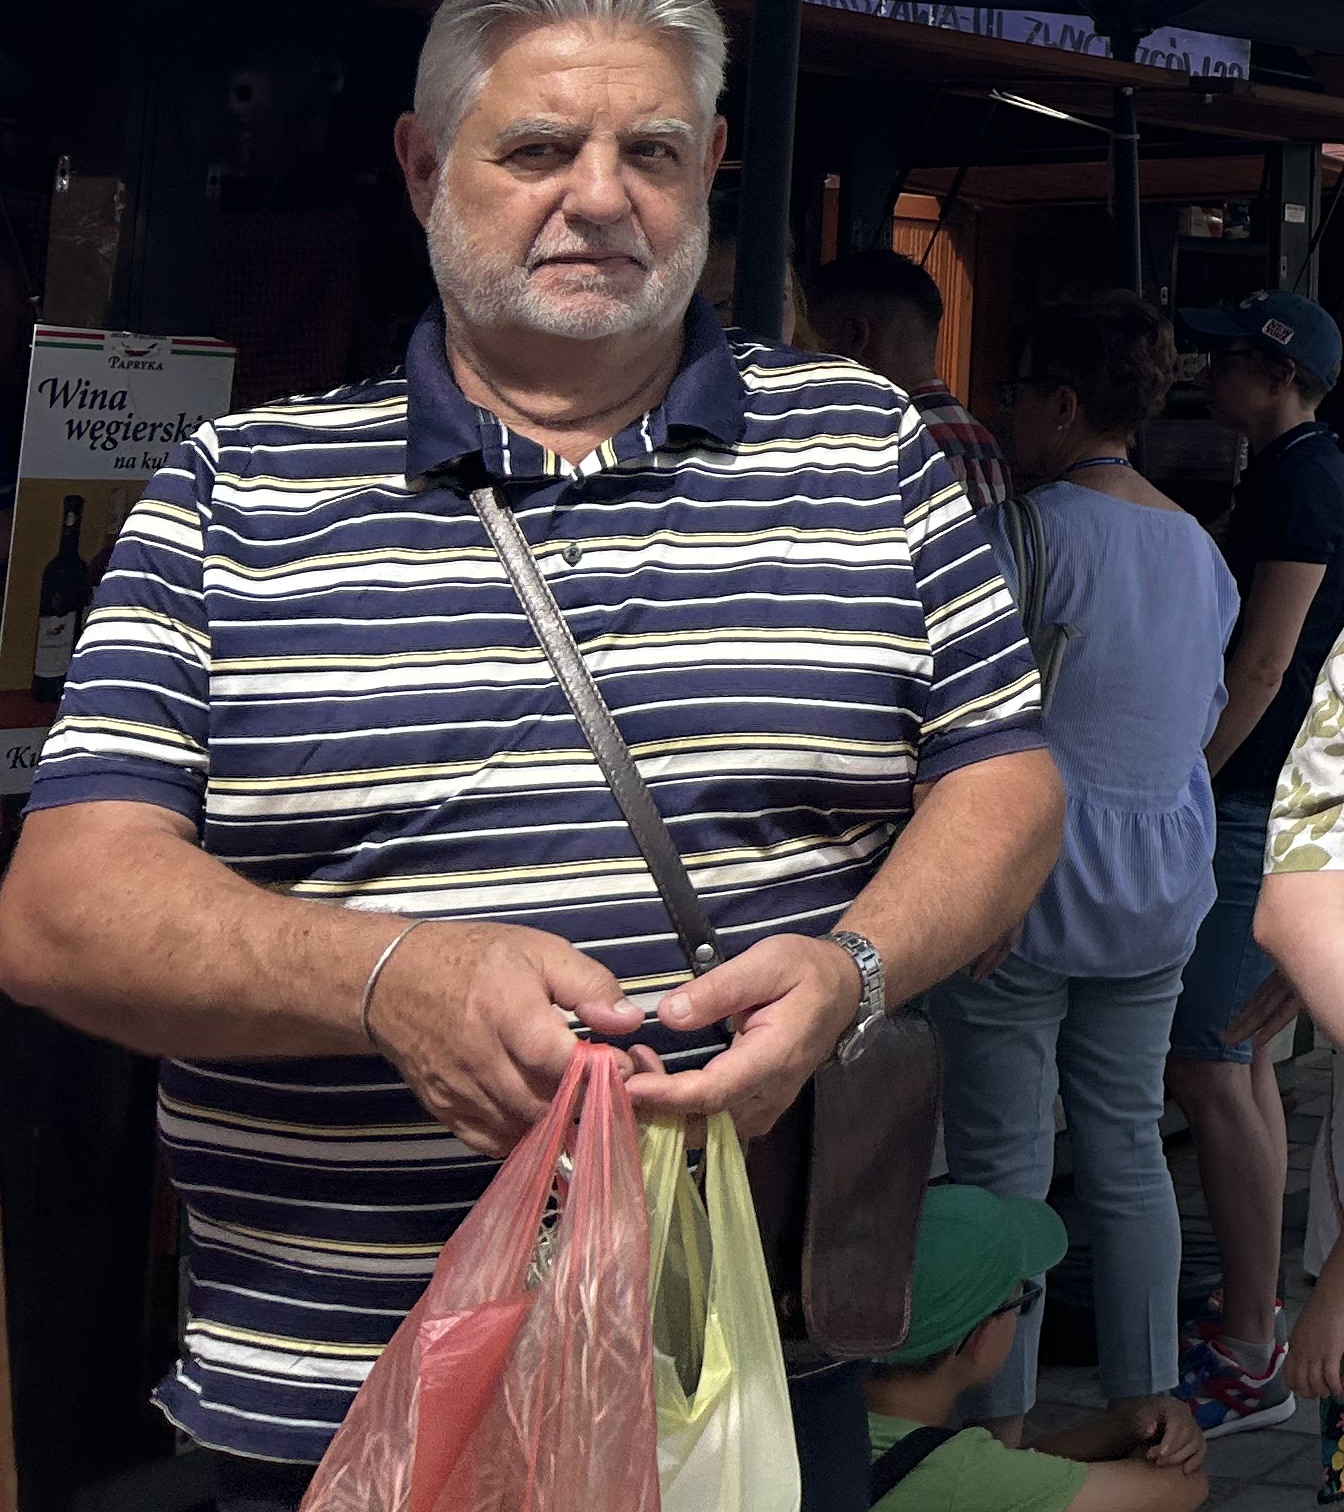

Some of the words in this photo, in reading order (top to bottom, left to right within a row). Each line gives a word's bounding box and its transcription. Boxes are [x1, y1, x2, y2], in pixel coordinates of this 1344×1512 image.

[108, 355, 164, 371] PAPRYKA
[38, 377, 128, 411] Wina
[65, 412, 203, 451] węgierski
[113, 455, 136, 469] na
[6, 745, 39, 769] Ku
